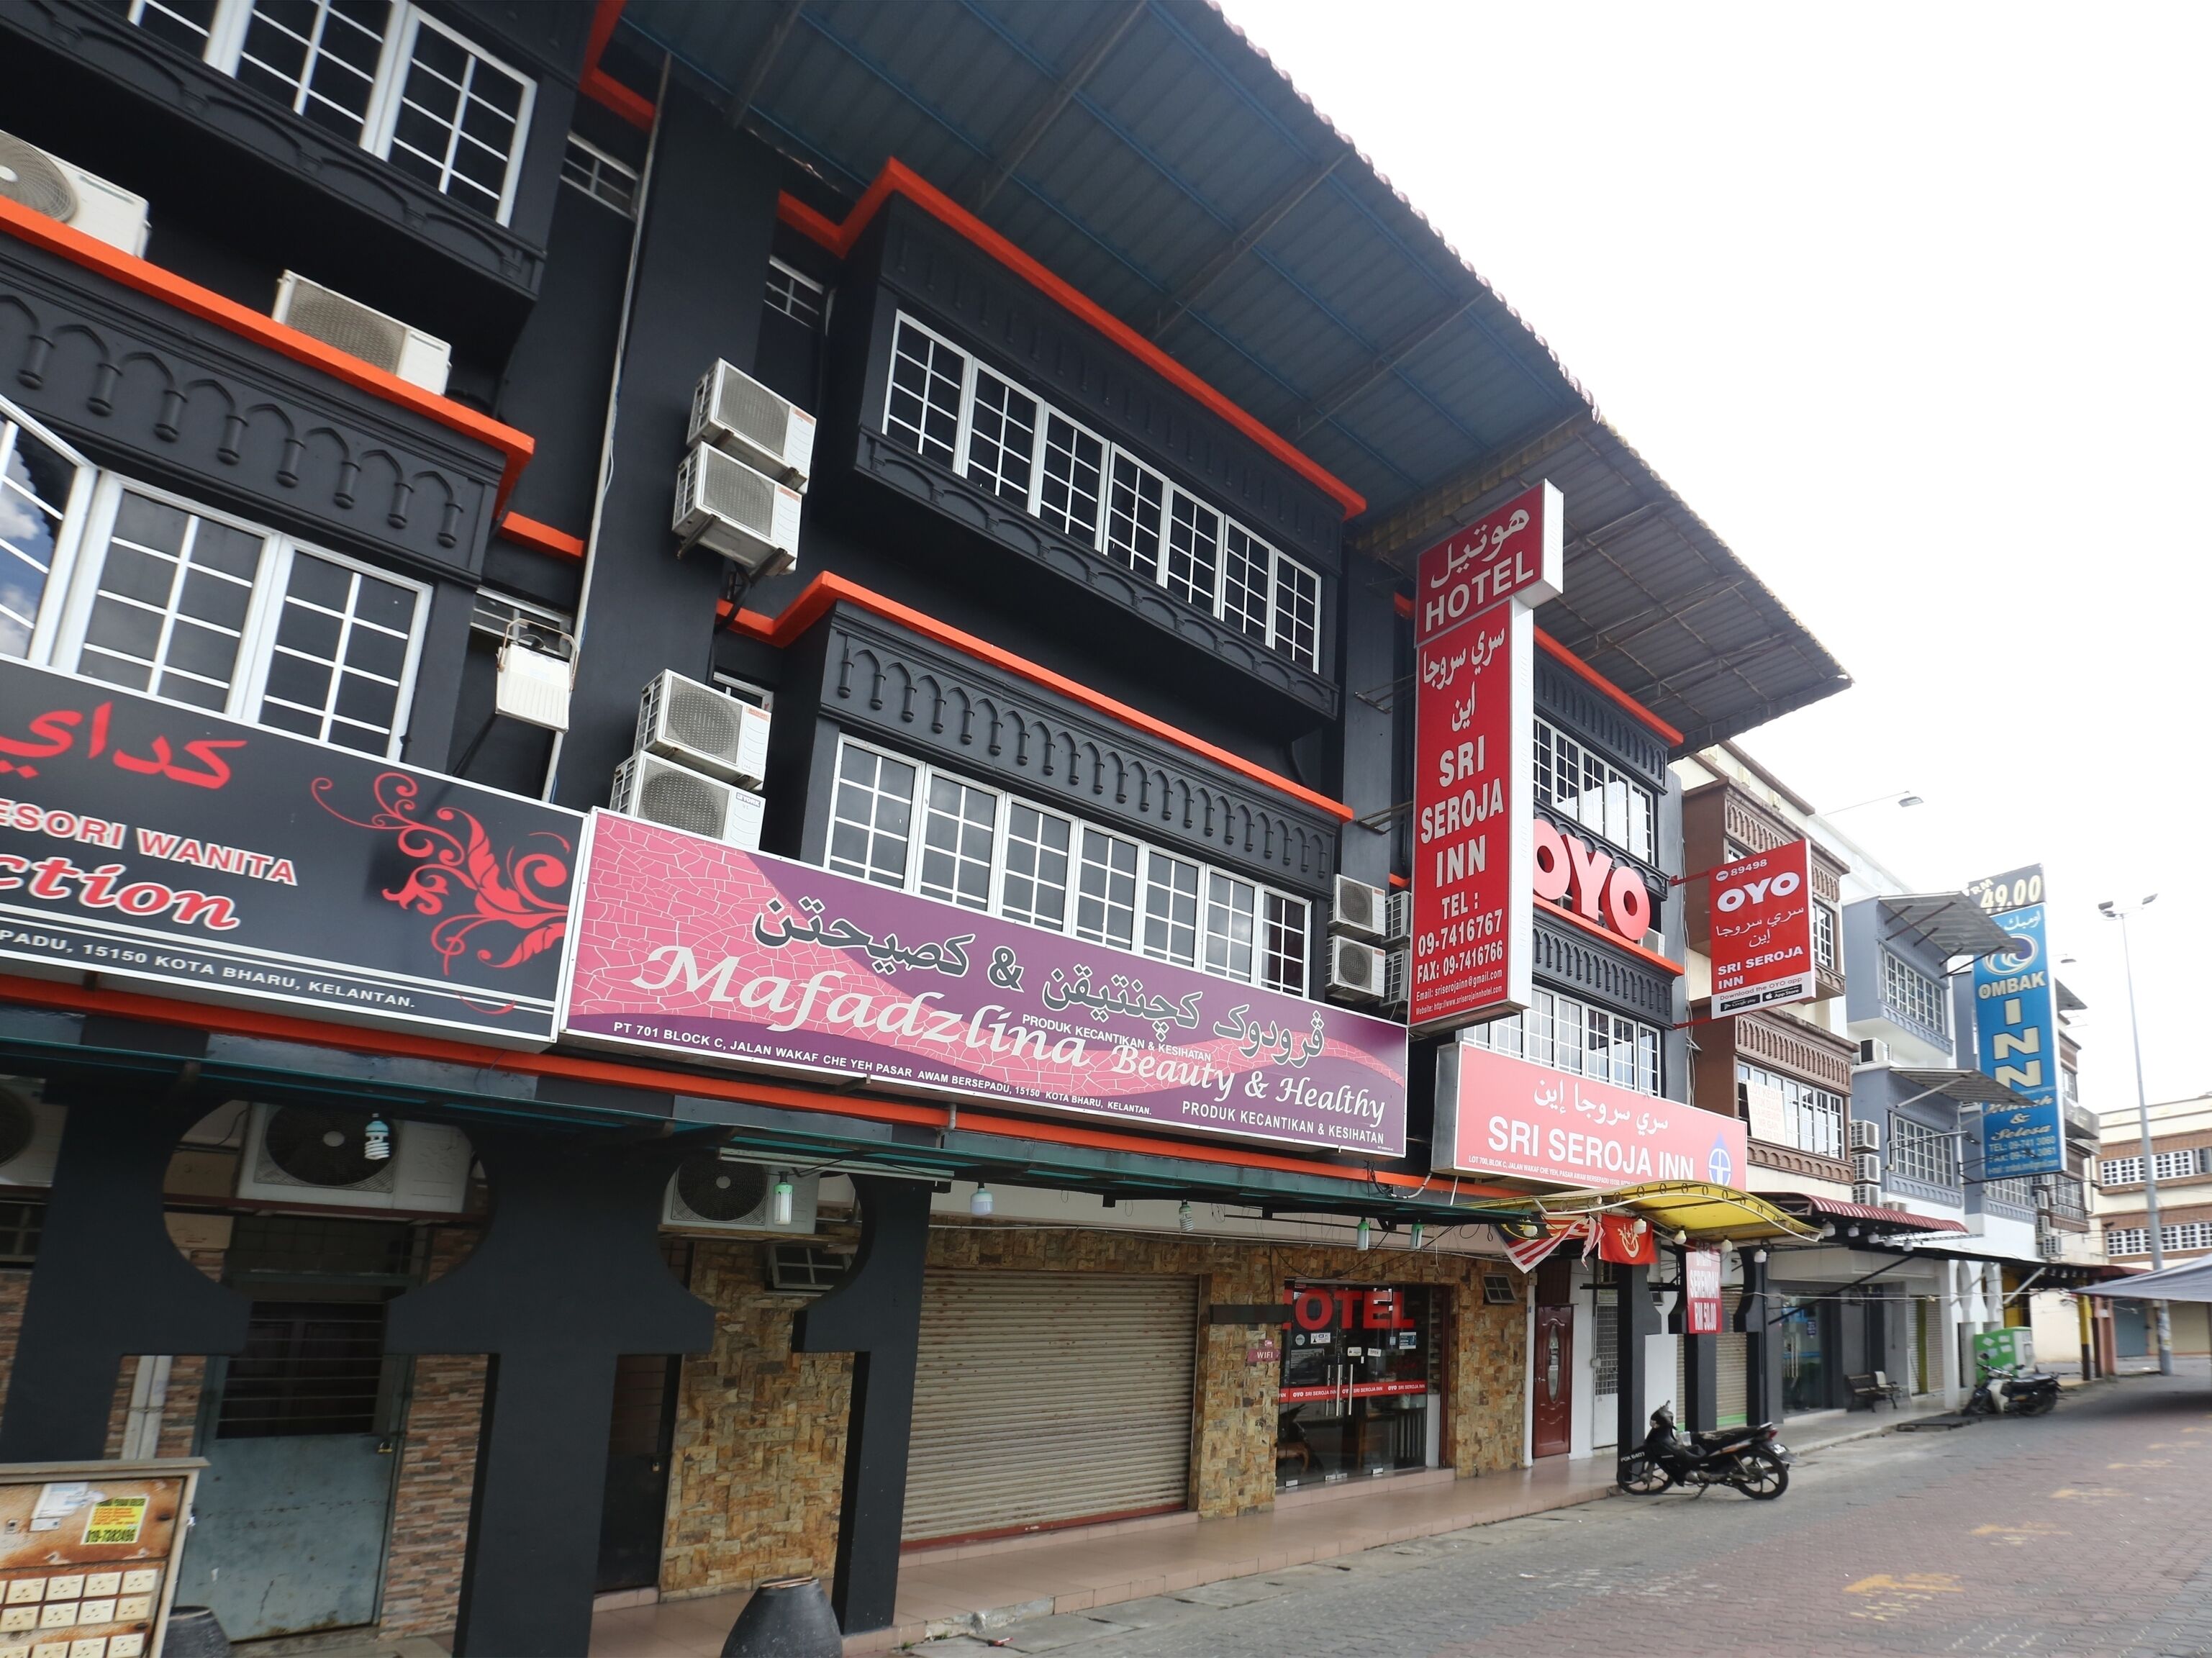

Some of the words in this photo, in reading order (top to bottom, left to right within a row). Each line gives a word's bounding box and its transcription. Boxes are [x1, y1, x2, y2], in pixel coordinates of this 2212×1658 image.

[1425, 551, 1534, 633] HOTEL
[1438, 735, 1485, 787] SRI
[742, 794, 760, 807] YORK
[1420, 778, 1504, 844] SEROJA
[137, 828, 297, 886] WANITA
[1436, 834, 1486, 888] INN
[1533, 818, 1651, 941] OYO
[1731, 859, 1768, 876] 89498
[1441, 892, 1468, 920] TEL
[1717, 872, 1800, 912] OYO
[1980, 875, 2041, 914] 49.00
[1418, 908, 1502, 957] 09-7416767
[82, 943, 148, 964] 15150
[154, 955, 215, 976] KOTA
[222, 967, 301, 991] BHARU,
[309, 982, 416, 1008] KELANTAN.
[987, 946, 1025, 993] &
[1417, 960, 1439, 984] FAX:
[1443, 940, 1502, 977] 09-7416766
[1718, 961, 1741, 975] SRI
[1745, 946, 1803, 968] SEROJA
[1718, 975, 1744, 989] INN
[631, 946, 1091, 1069] Mafadzlina
[1416, 989, 1433, 1002] Email:
[1434, 969, 1502, 997] sriserojainn@gmail.com
[1720, 987, 1754, 1000] Download
[1979, 971, 2046, 1000] OMBAK
[1415, 1005, 1433, 1015] Website:
[1022, 1013, 1071, 1034] PRODUK
[1075, 1025, 1145, 1049] KECANTIKAN
[1148, 1041, 1155, 1051] &
[1158, 1043, 1212, 1062] KESIHATAN
[1993, 997, 2042, 1088] INN
[613, 1021, 632, 1033] PT
[636, 1025, 658, 1038] 701
[663, 1029, 710, 1046] BLOCK
[714, 1038, 726, 1051] C,
[730, 1041, 772, 1056] JALAN
[775, 1047, 819, 1063] WAKAF
[822, 1055, 847, 1067] CHE
[850, 1059, 873, 1071] YEH
[876, 1063, 912, 1077] PASAR
[917, 1070, 948, 1083] AWAM
[951, 1075, 1012, 1095] BERSEPADU,
[1015, 1086, 1040, 1097] 15150
[1046, 1090, 1069, 1102] KOTA
[1071, 1093, 1103, 1109] BHARU,
[1107, 1100, 1152, 1115] KELANTAN.
[1110, 1044, 1236, 1102] Beauty
[1243, 1071, 1269, 1098] &
[1275, 1077, 1386, 1128] Healthy
[1182, 1101, 1236, 1122] PRODUK
[1240, 1110, 1314, 1135] KECANTIKAN
[1317, 1123, 1325, 1135] &
[1328, 1125, 1384, 1145] KESIHATAN
[1487, 1115, 1539, 1157] SRI
[1548, 1128, 1653, 1177] SEROJA
[1659, 1151, 1694, 1180] INN
[1479, 1157, 1489, 1166] 700,
[1489, 1159, 1502, 1167] BLOK
[1508, 1162, 1523, 1171] JALAN
[1523, 1164, 1540, 1173] WAKAF
[1559, 1170, 1574, 1179] PASAR
[1574, 1172, 1587, 1181] AWAM
[1587, 1174, 1610, 1184] BERSEPADU
[1282, 1288, 1415, 1331] OTEL
